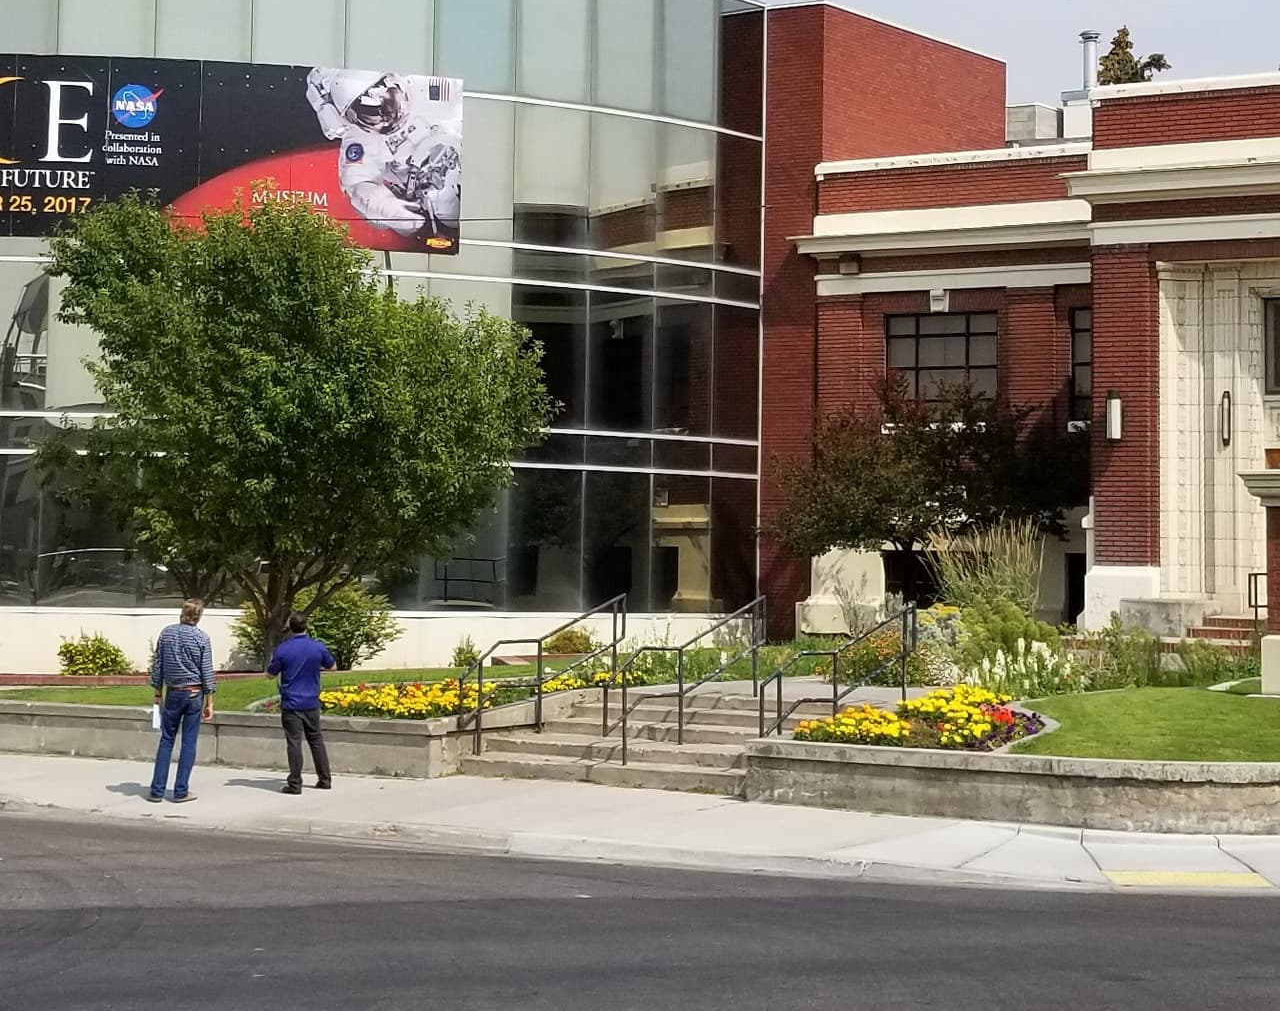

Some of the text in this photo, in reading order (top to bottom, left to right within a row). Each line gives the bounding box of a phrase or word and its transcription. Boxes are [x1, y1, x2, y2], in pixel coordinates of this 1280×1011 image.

[115, 100, 154, 112] NASA
[105, 130, 160, 141] Presented in
[102, 142, 162, 154] collaboration
[106, 155, 158, 166] with NASA
[2, 170, 91, 189] FUTURE
[9, 196, 37, 216] 25,
[43, 197, 92, 213] 2017
